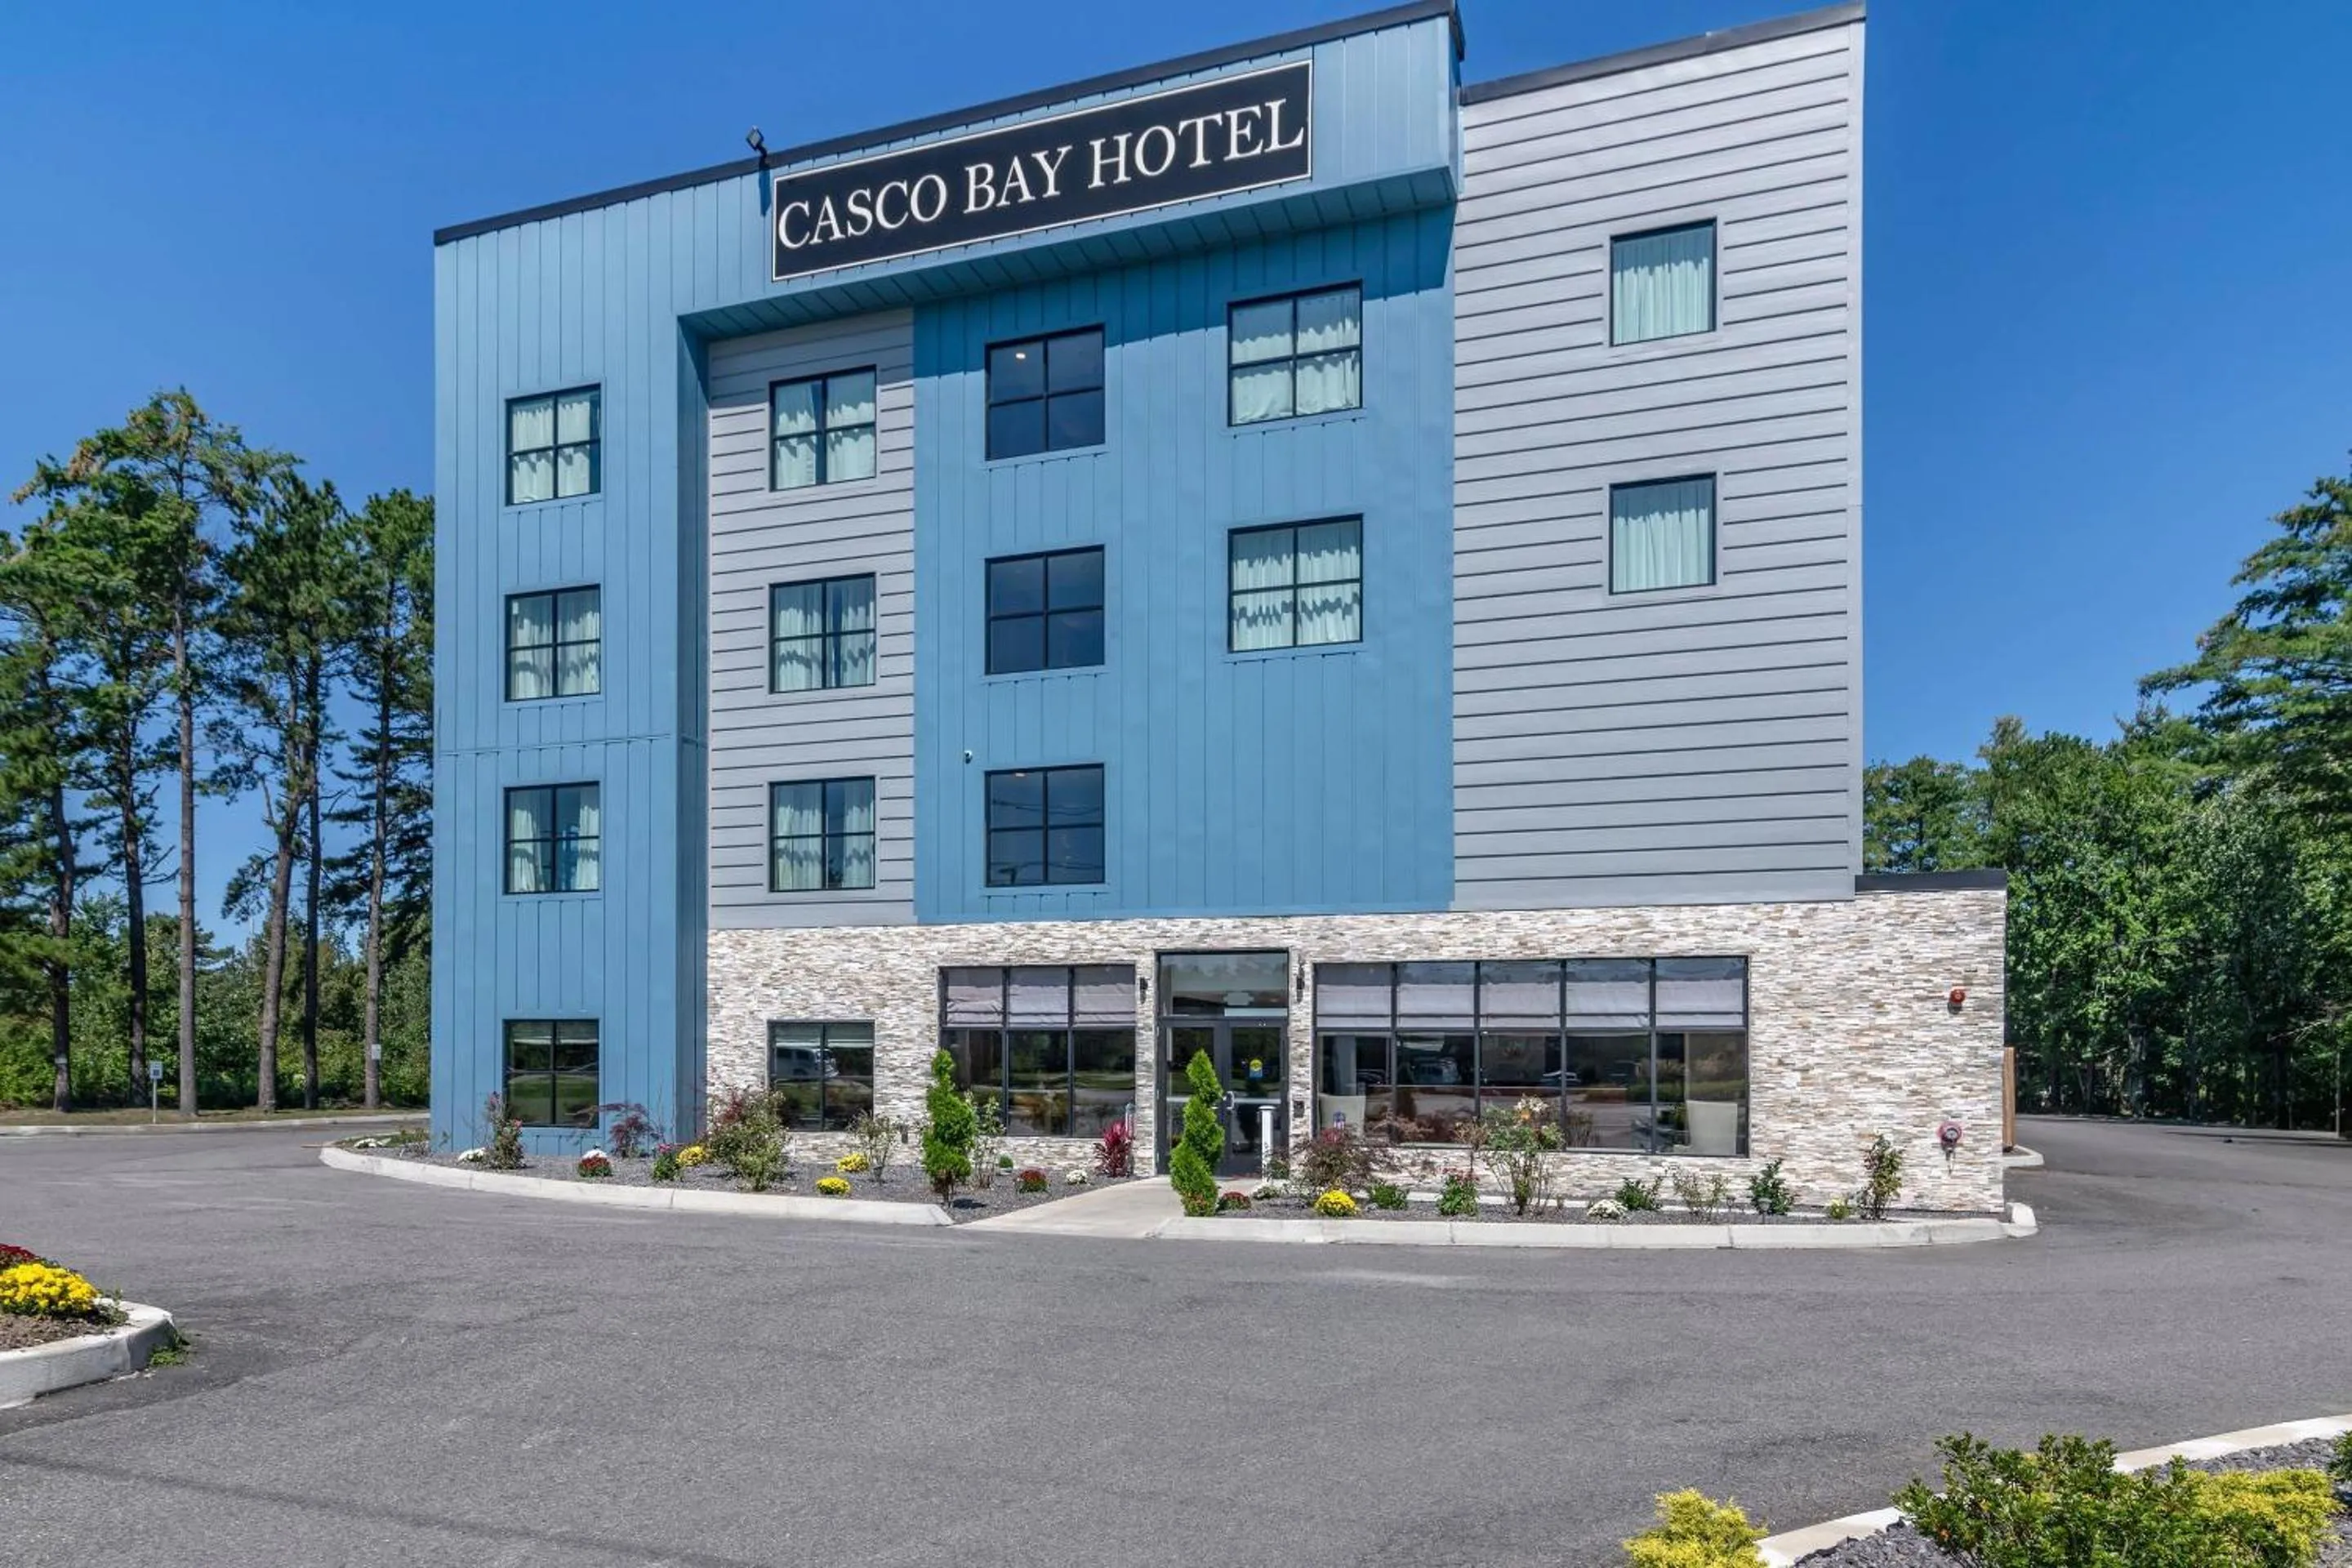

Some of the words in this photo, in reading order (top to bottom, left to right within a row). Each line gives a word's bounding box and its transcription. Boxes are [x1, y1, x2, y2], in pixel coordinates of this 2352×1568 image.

[777, 173, 947, 250] CASCO
[963, 145, 1073, 214] BAY
[1088, 98, 1305, 189] HOTEL
